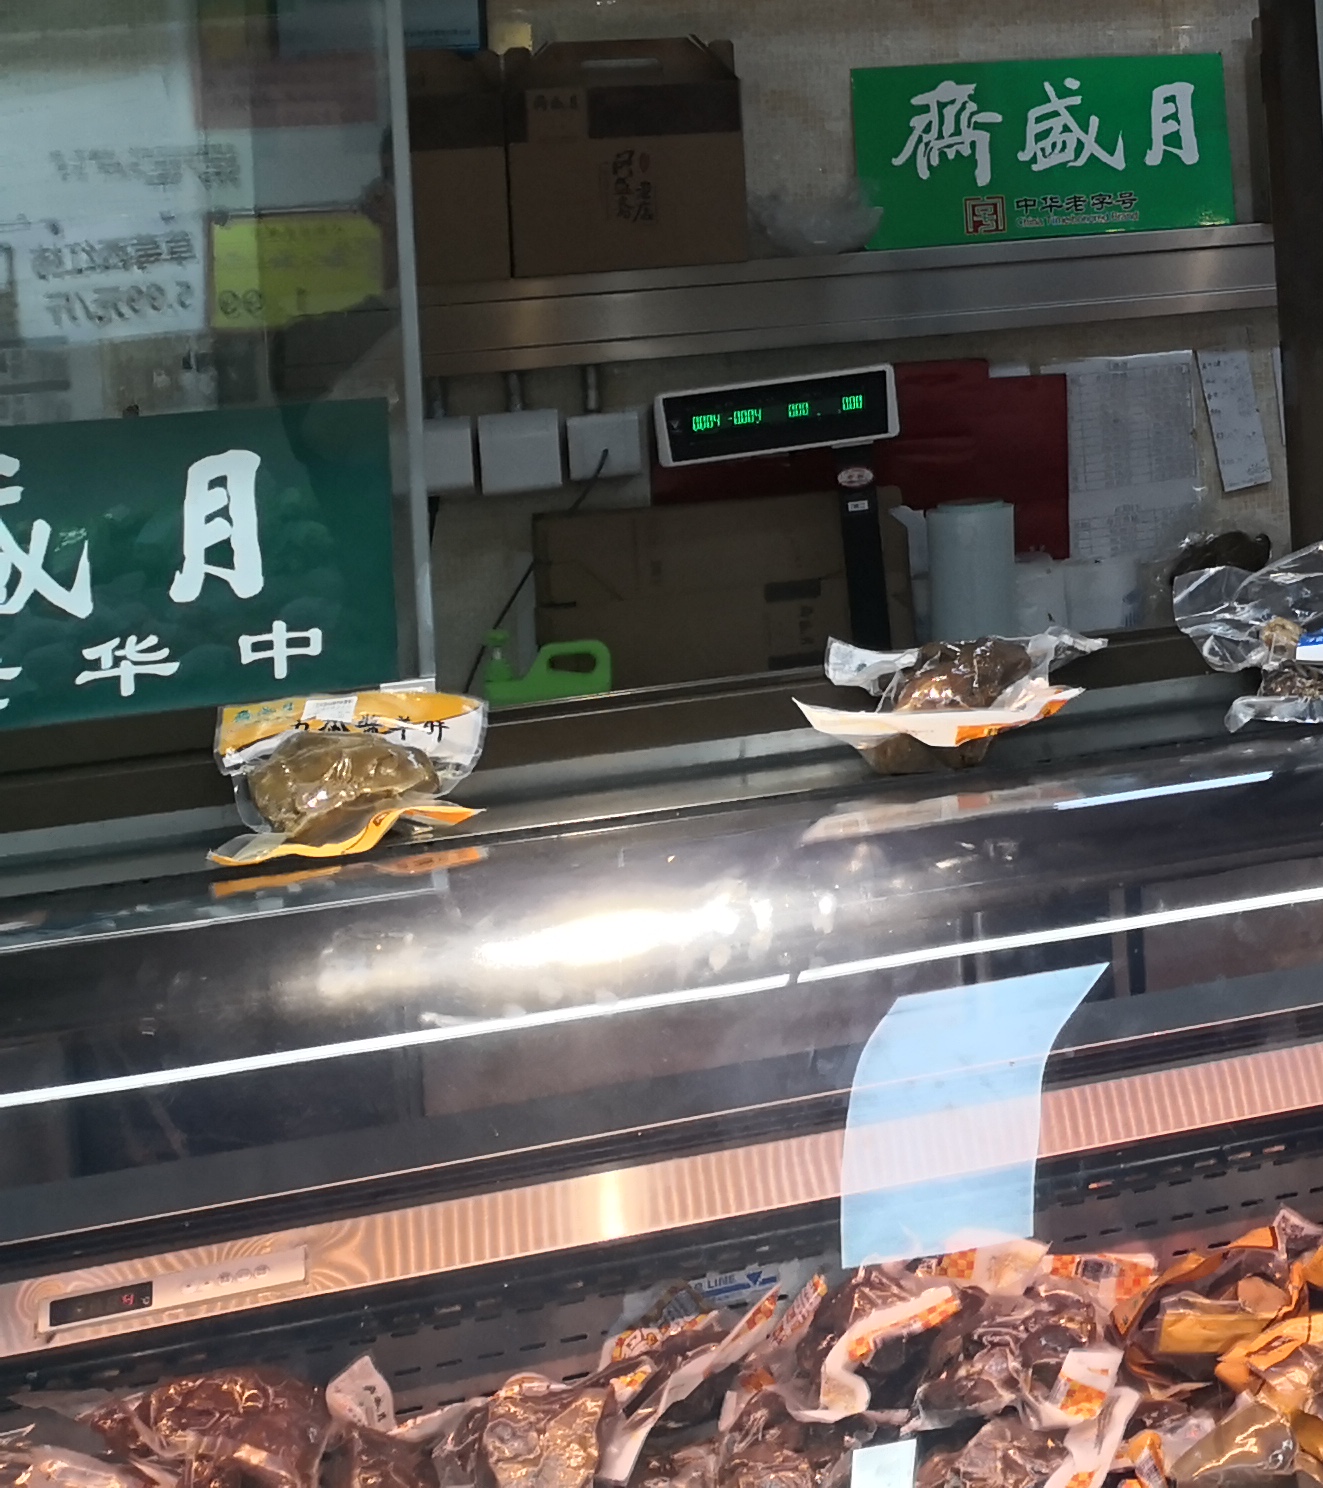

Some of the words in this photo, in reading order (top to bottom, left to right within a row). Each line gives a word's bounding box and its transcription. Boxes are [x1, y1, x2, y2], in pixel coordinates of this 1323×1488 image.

[1015, 192, 1138, 214] 中华老字号
[0, 620, 323, 711] 中华
